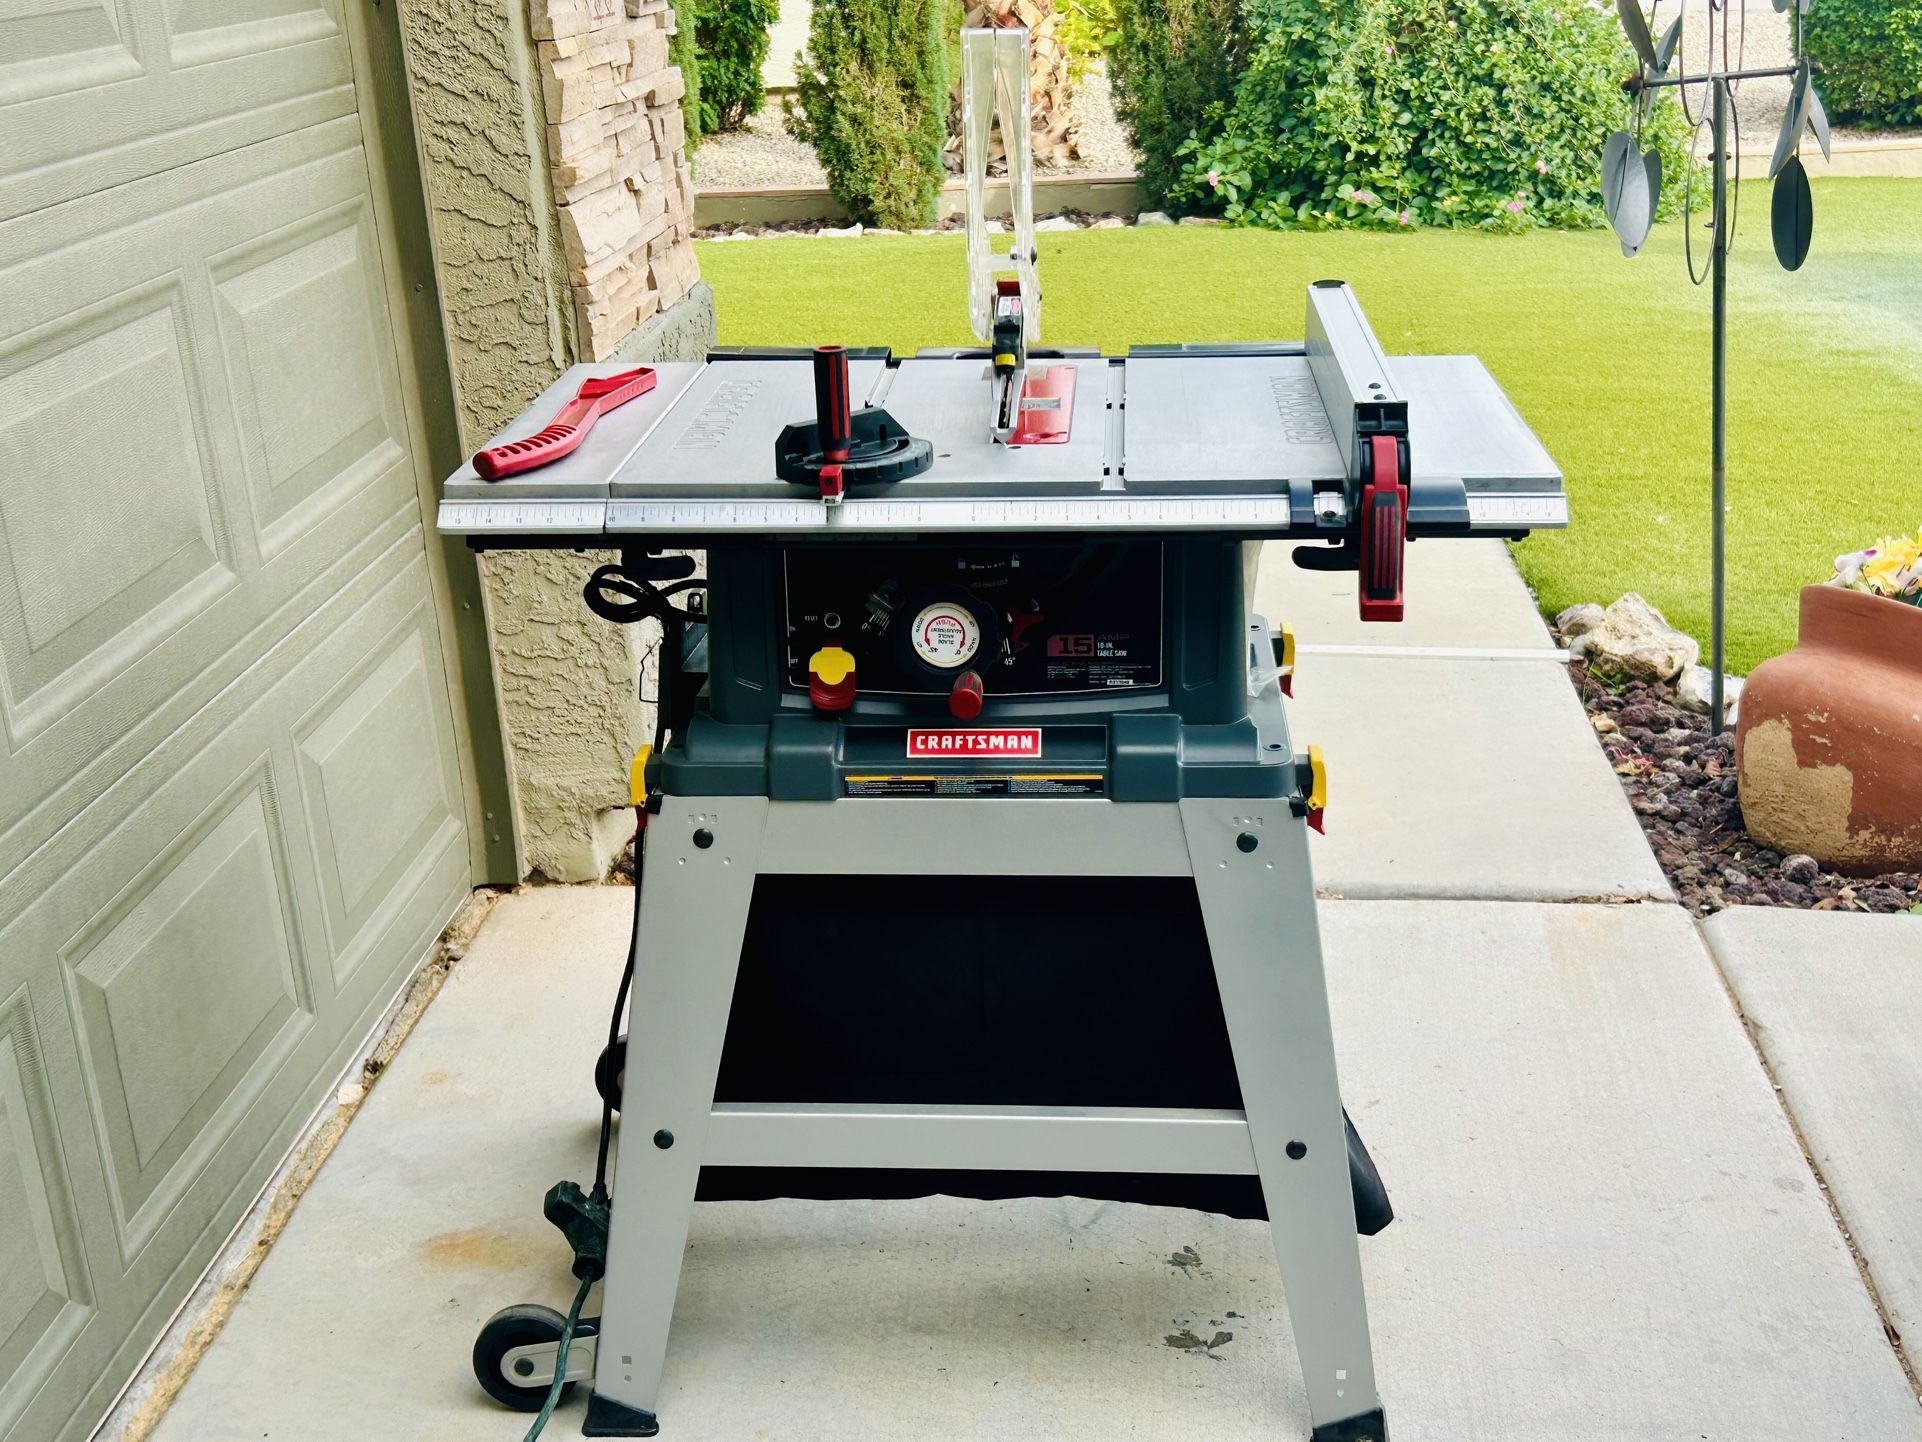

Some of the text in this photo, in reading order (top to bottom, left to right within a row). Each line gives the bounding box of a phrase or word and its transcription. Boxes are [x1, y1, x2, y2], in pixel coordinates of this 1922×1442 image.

[1268, 375, 1334, 445] CRAFTSMAN
[1058, 633, 1130, 655] 15 AMP
[915, 735, 1033, 749] CRAFTSMAN
